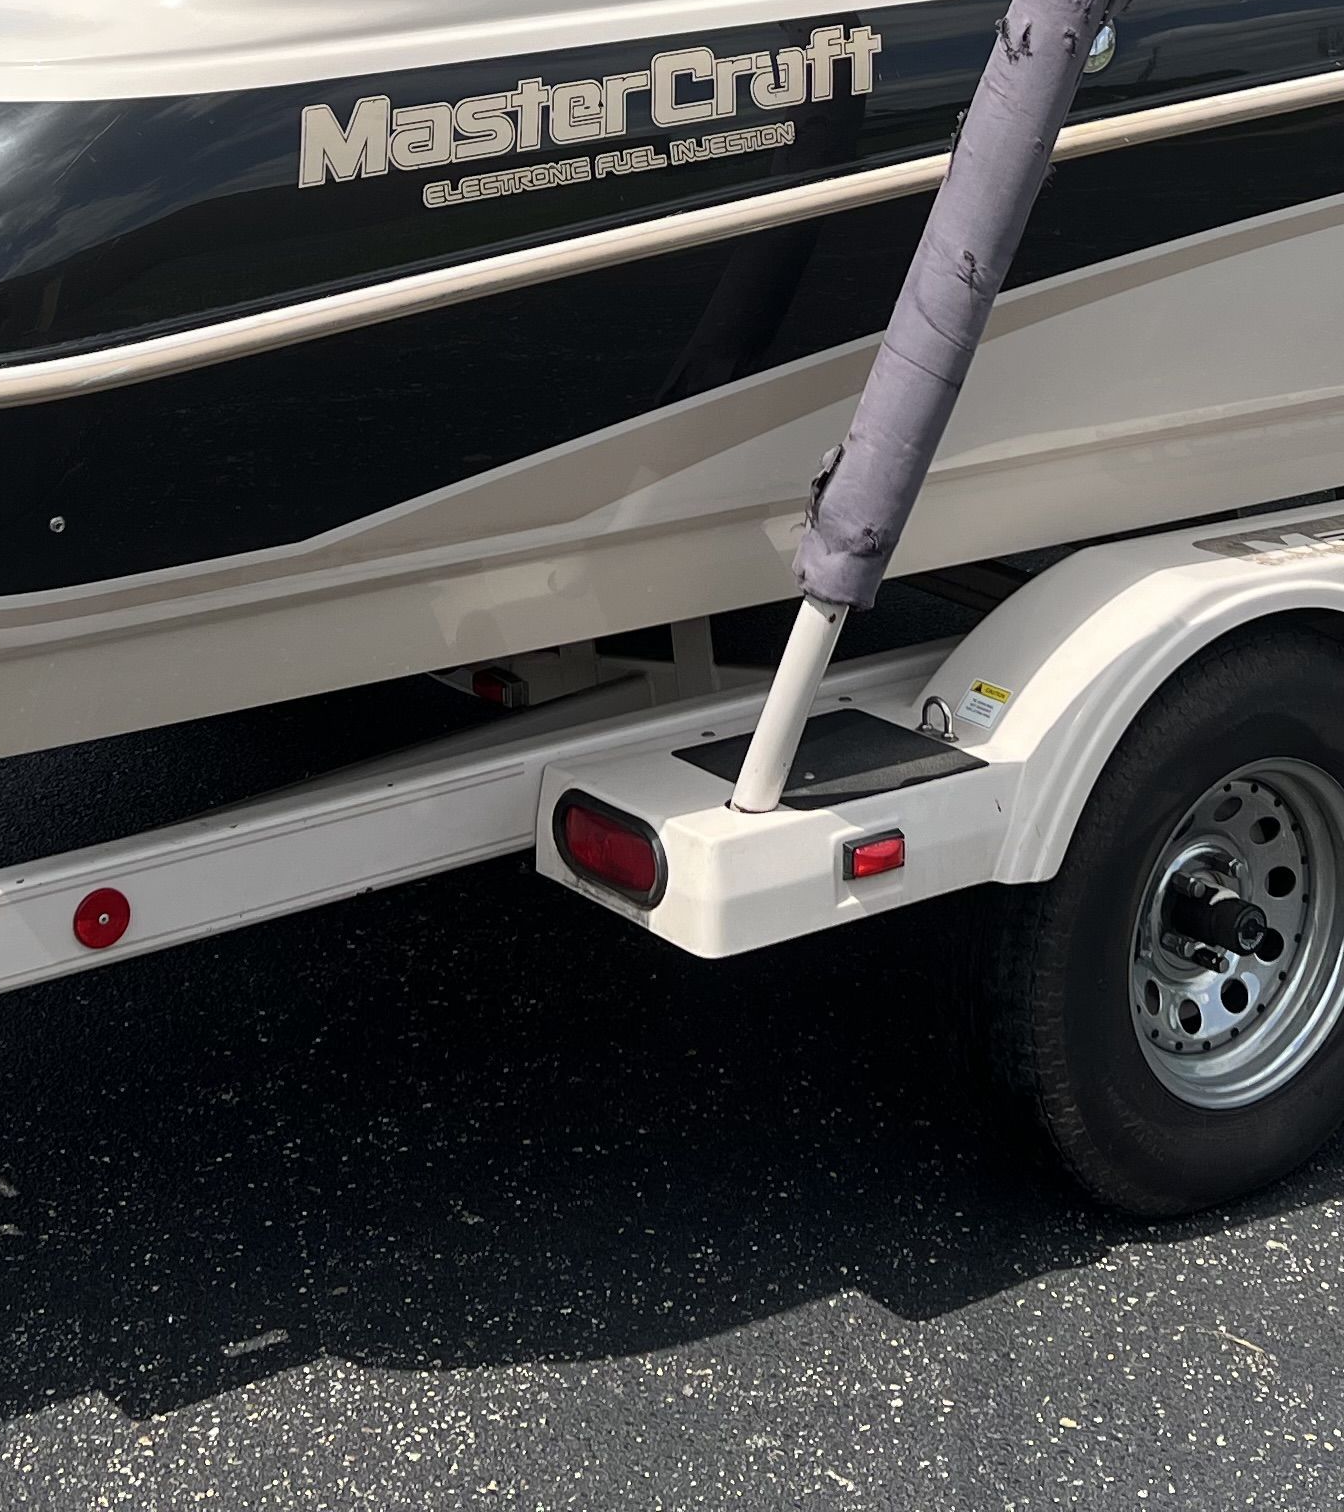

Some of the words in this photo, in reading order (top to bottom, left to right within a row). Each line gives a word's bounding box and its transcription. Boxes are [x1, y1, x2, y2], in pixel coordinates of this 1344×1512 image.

[299, 24, 881, 188] MasterCraft
[422, 156, 592, 209] ELECTRONIC
[595, 145, 668, 181] FUEL
[670, 120, 796, 165] INJECTION
